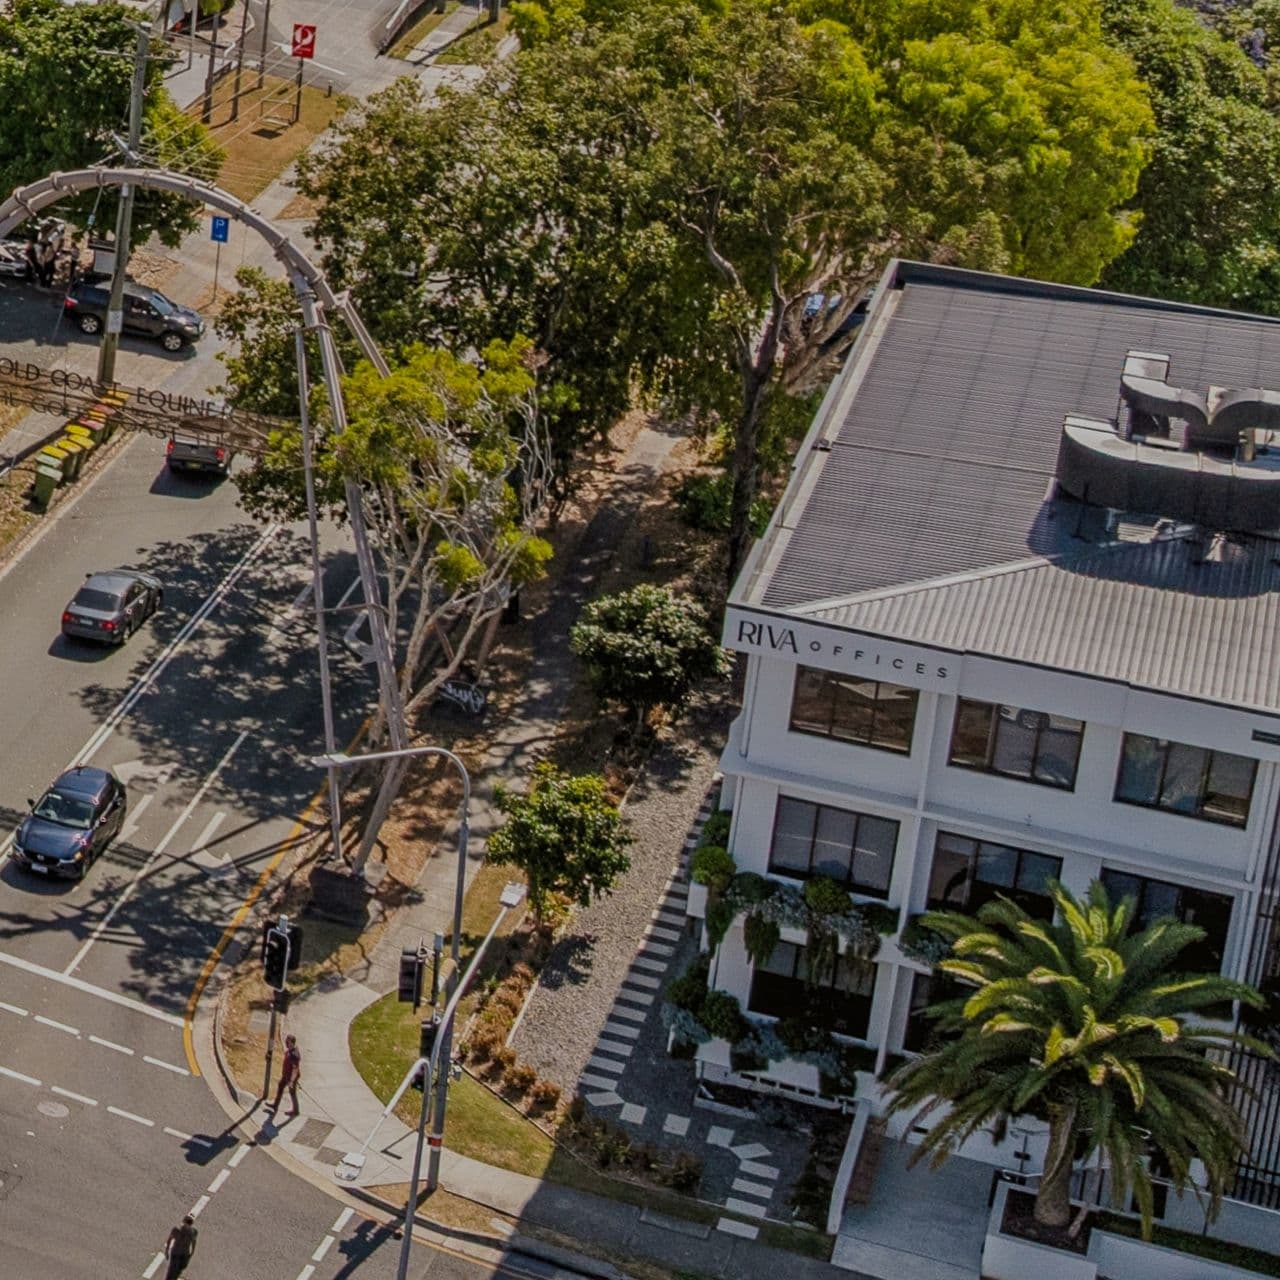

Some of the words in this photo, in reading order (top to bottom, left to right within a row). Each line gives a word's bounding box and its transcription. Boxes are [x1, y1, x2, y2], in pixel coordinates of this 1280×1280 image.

[136, 386, 215, 417] EQUINE
[737, 620, 799, 654] RIVA
[809, 640, 948, 679] OFFICES
